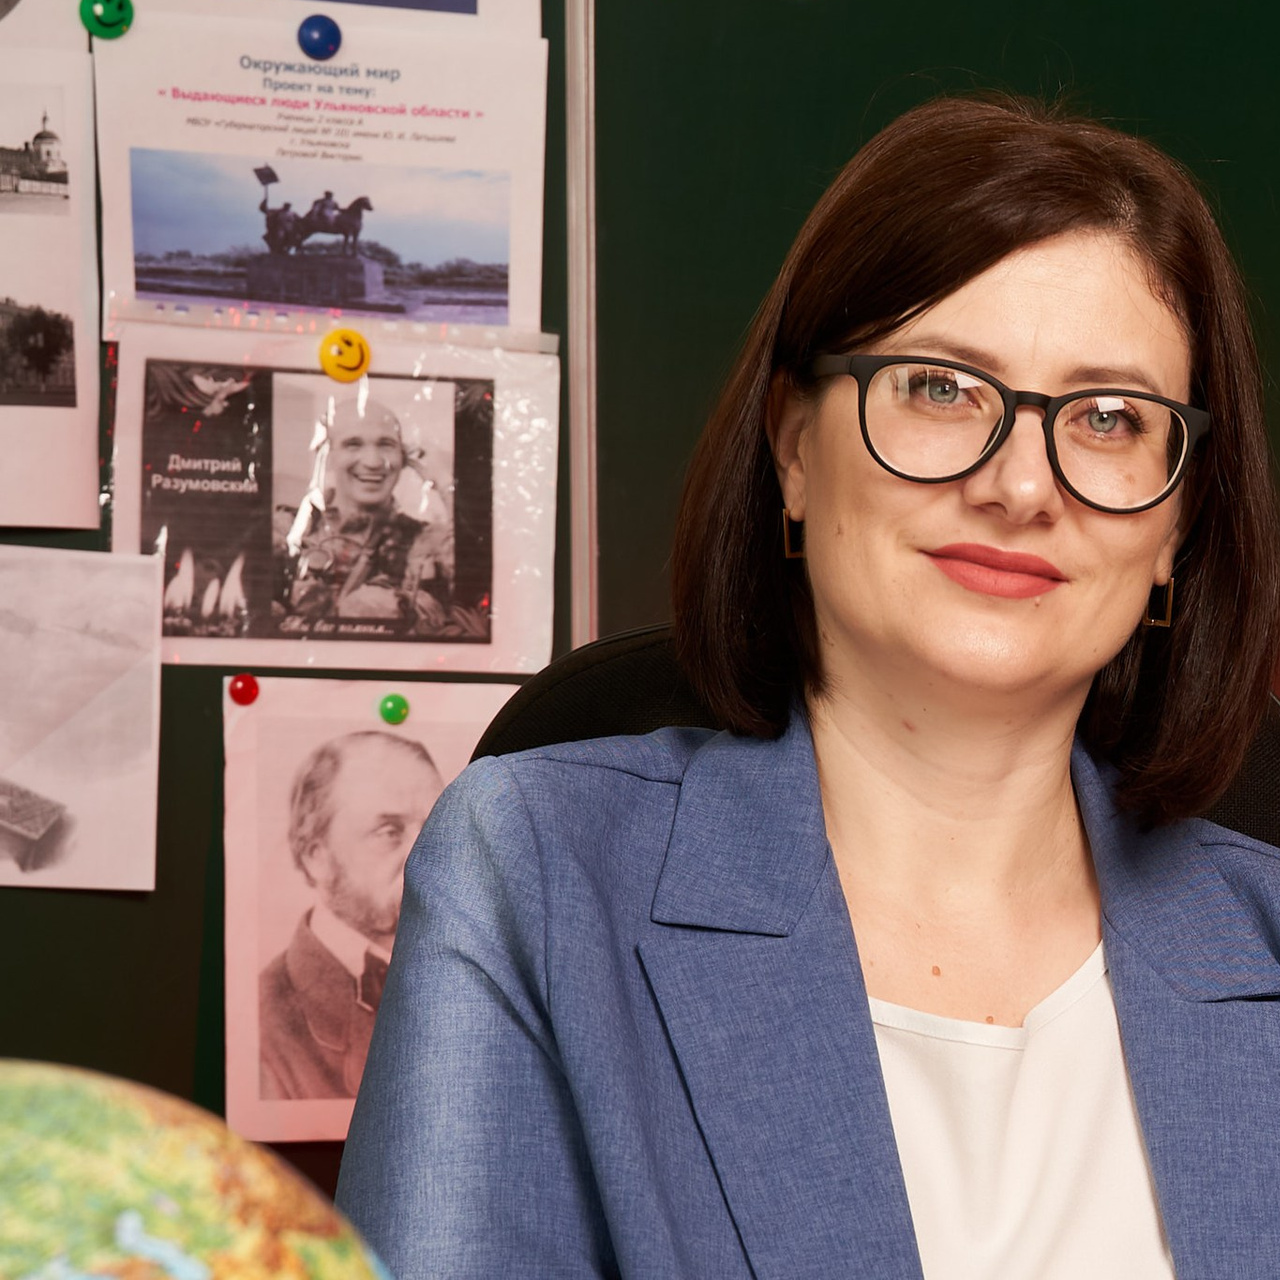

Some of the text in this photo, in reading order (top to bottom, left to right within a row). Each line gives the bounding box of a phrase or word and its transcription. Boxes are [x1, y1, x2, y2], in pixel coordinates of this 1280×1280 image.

[240, 55, 401, 82] Окружающий мир
[263, 77, 376, 98] Проект на тему:
[171, 87, 267, 106] Выдающиеся
[270, 98, 310, 110] люди
[315, 99, 407, 116] Ульяновской
[411, 104, 470, 119] области
[168, 454, 242, 474] Дмитрий
[152, 473, 259, 494] Разумовский
